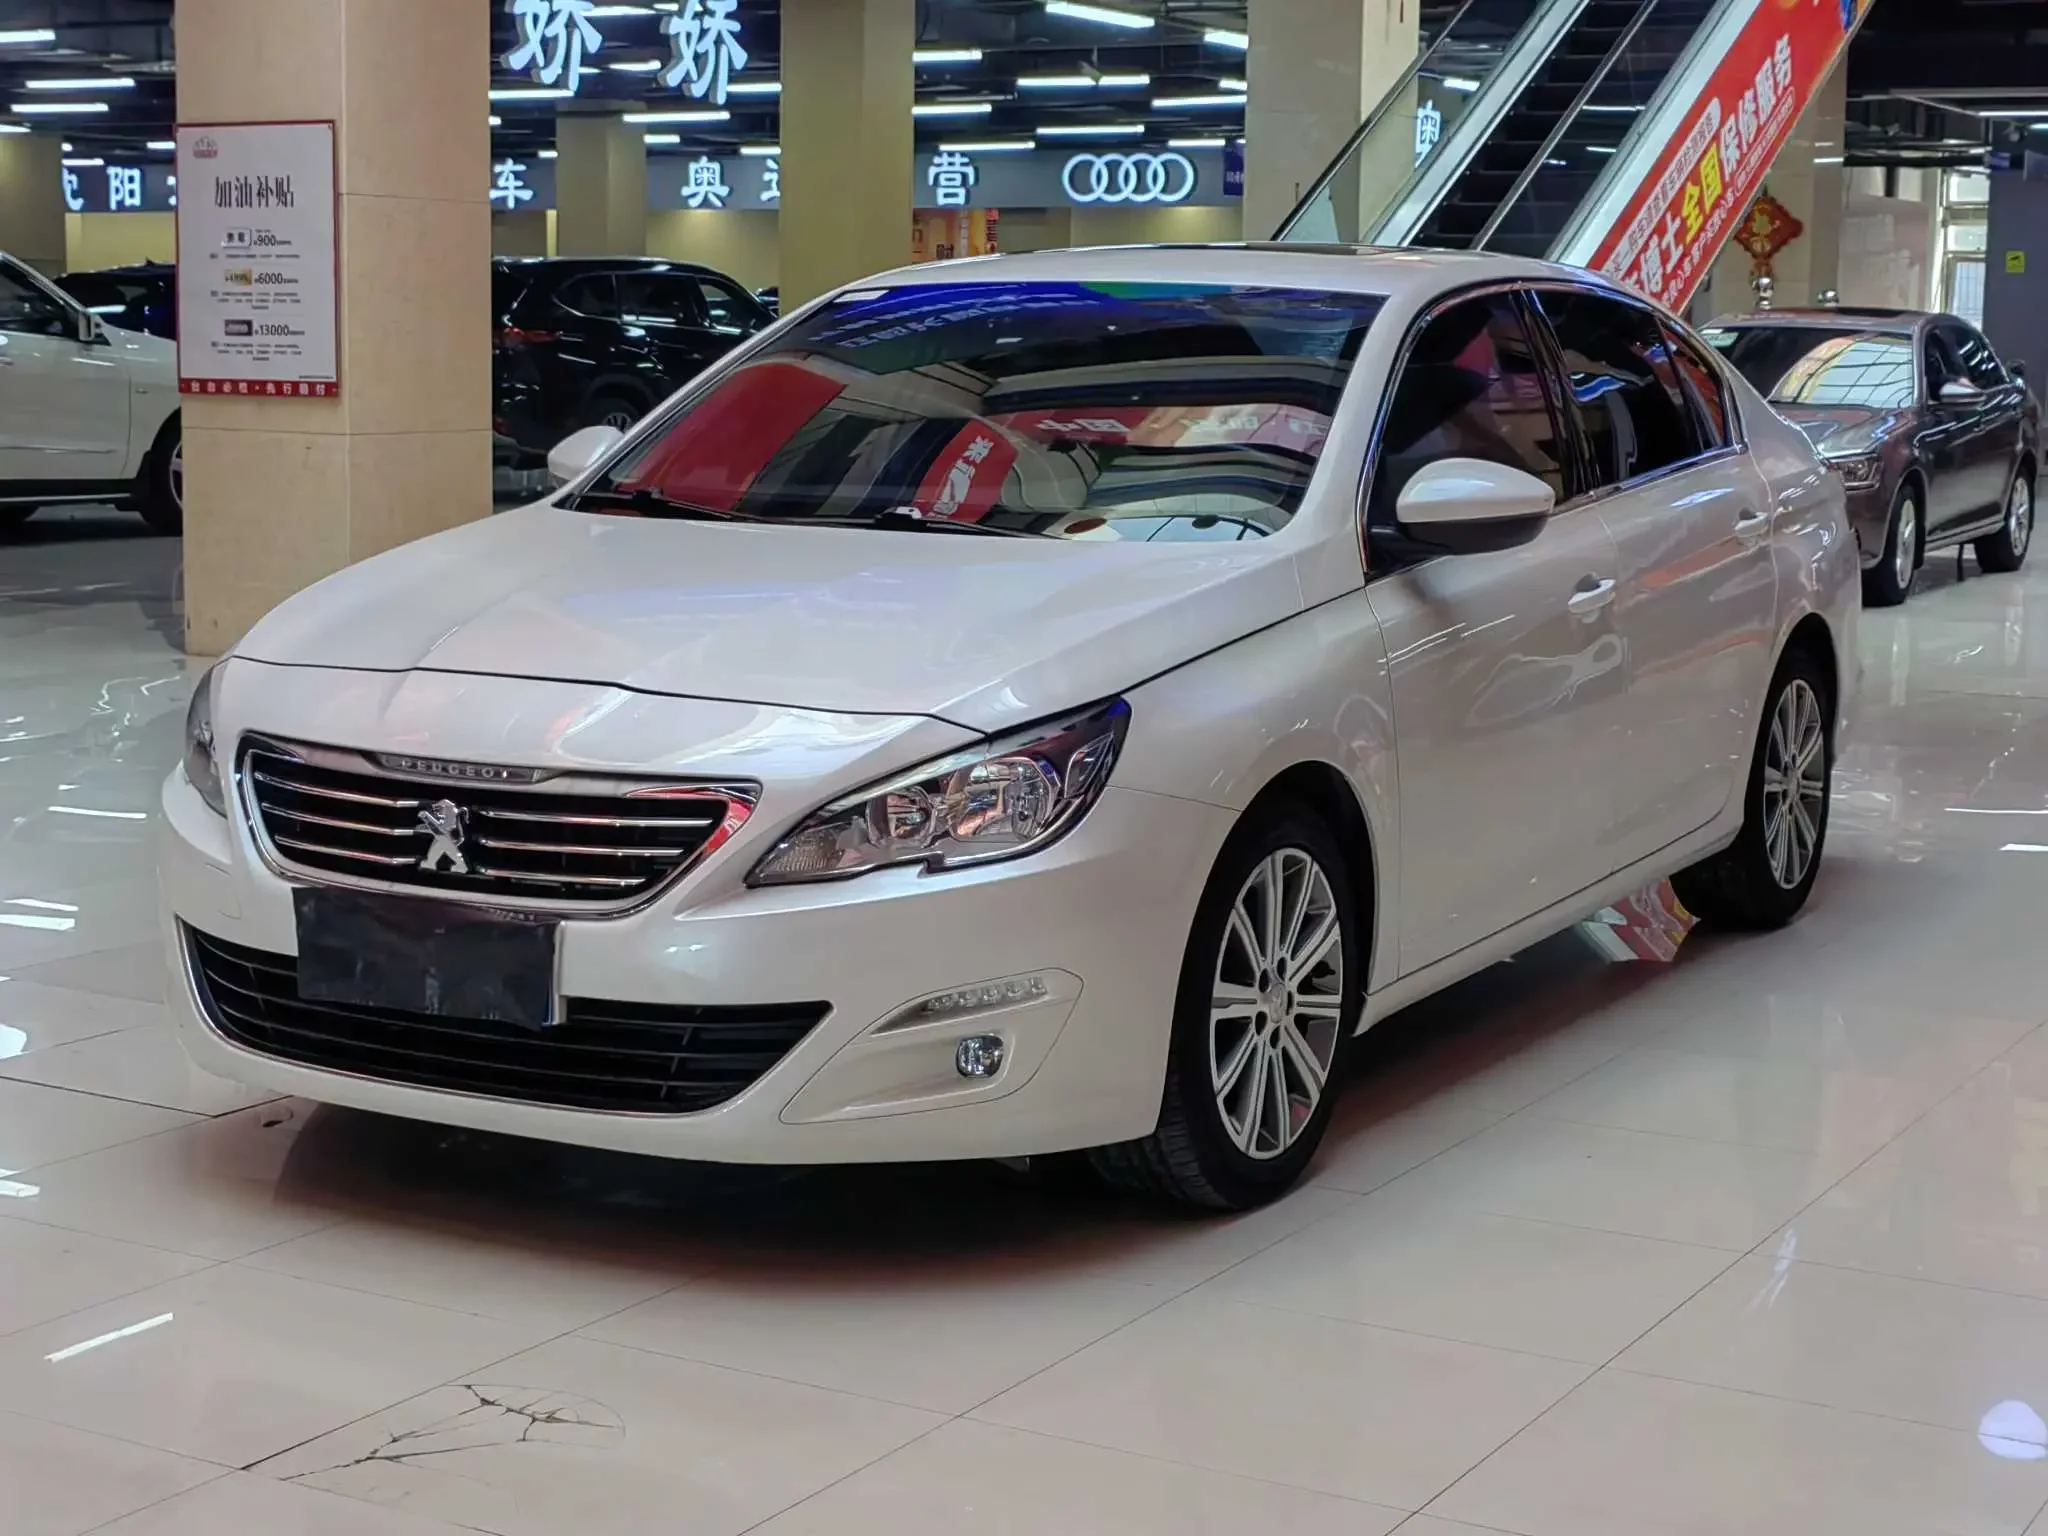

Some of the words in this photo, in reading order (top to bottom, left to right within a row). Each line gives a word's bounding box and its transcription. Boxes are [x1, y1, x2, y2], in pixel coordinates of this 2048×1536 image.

[214, 175, 295, 208] 加油补贴
[489, 158, 533, 209] 车
[928, 151, 975, 206] 营
